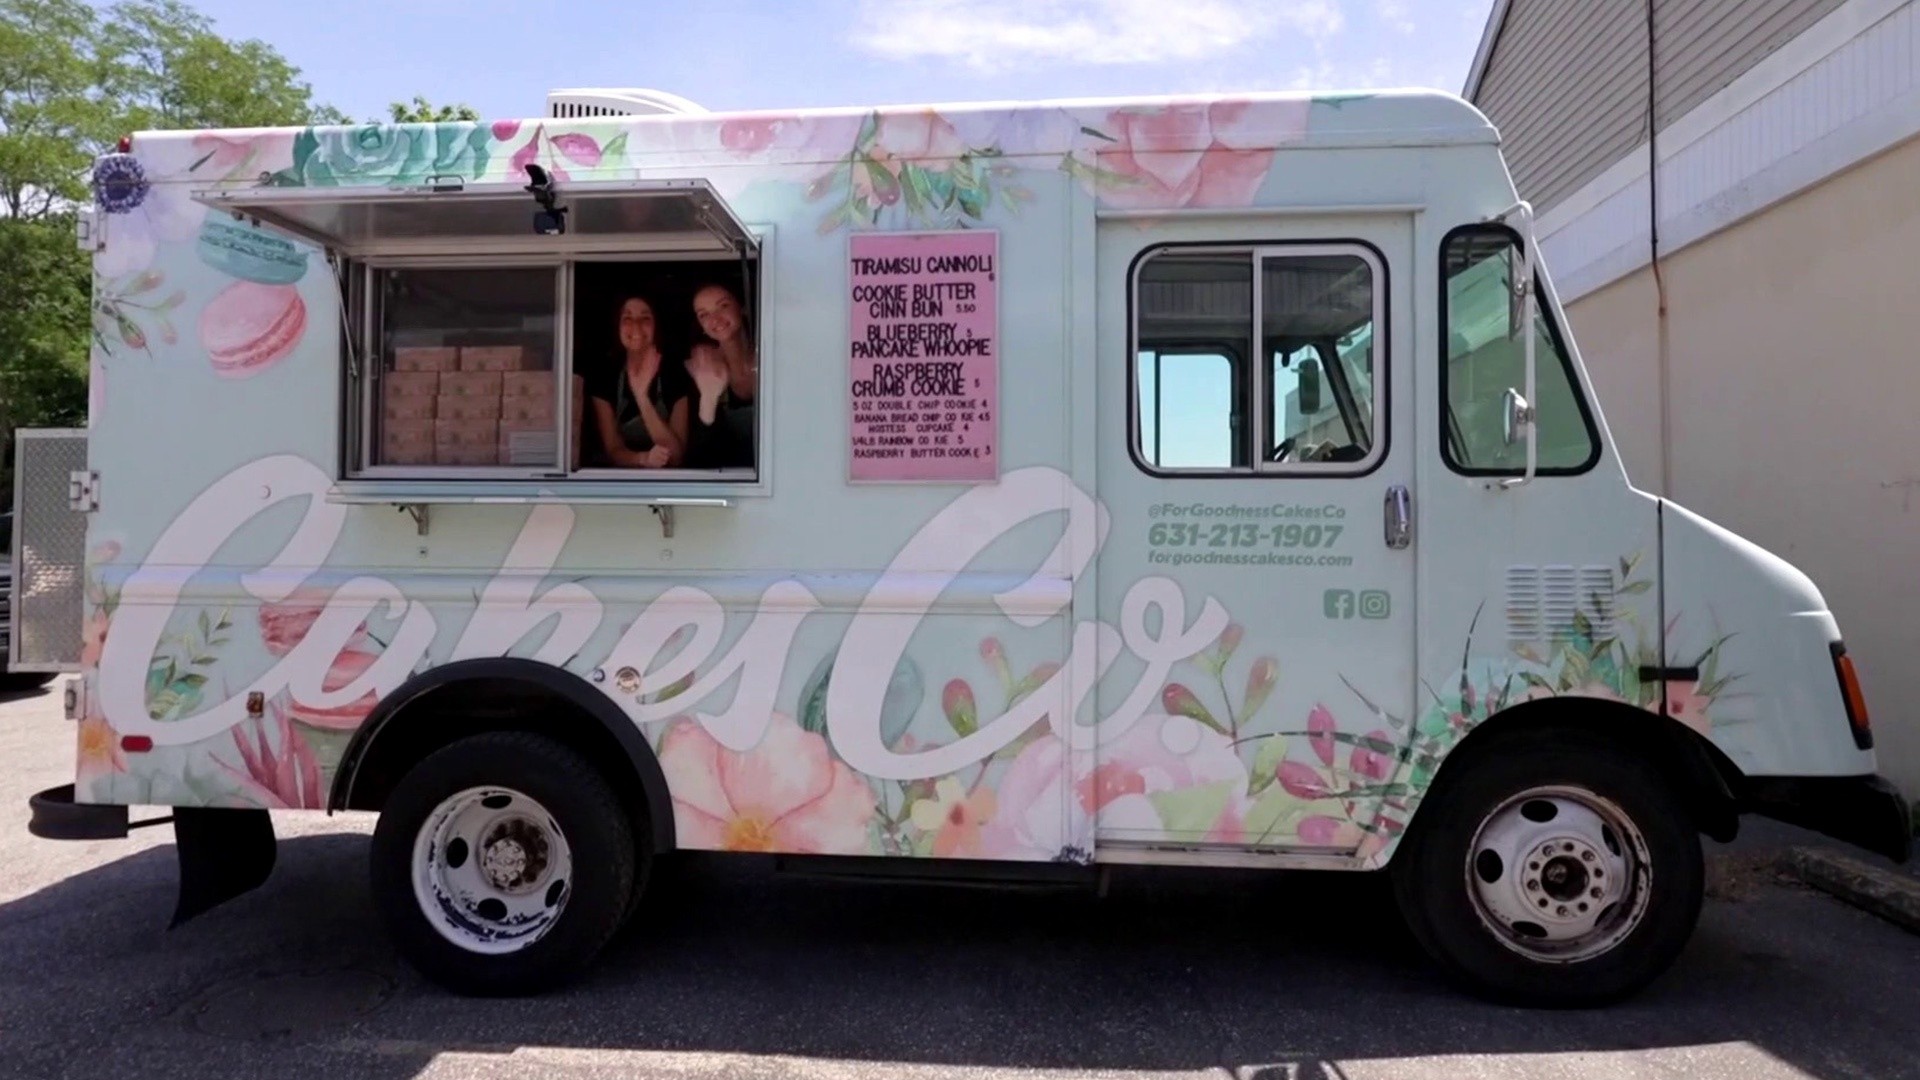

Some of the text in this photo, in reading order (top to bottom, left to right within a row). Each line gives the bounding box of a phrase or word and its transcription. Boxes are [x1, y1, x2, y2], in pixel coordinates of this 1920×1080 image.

[851, 255, 992, 275] TIRAMISU CANNOLI
[853, 283, 976, 302] COOKIE BUTTER
[869, 300, 906, 319] CINN
[912, 300, 943, 317] BUN
[867, 323, 972, 342] BLUEBERRY 5
[851, 338, 991, 358] PANCAKE WHOOPIE
[873, 362, 964, 379] RASPBERRY
[852, 380, 905, 397] CRUMB
[911, 379, 965, 396] COOKIE
[918, 401, 940, 409] CHIP
[982, 399, 987, 408] 4
[854, 414, 887, 423] BANANA
[891, 413, 918, 422] BREAD
[922, 414, 941, 422] CHIP
[868, 425, 906, 433] HOSTESS
[916, 424, 954, 432] CUPCAKE
[879, 437, 913, 445] RAINBOW
[958, 436, 964, 444] 5
[854, 449, 905, 458] RASPBERRY
[911, 449, 946, 458] BUTTER
[1147, 503, 1346, 519] @ForGoodnessCakesCo
[1148, 522, 1344, 548] 631-213-1907
[1147, 550, 1353, 567] forgoodnesscakesco.com
[97, 454, 822, 752] Cakes
